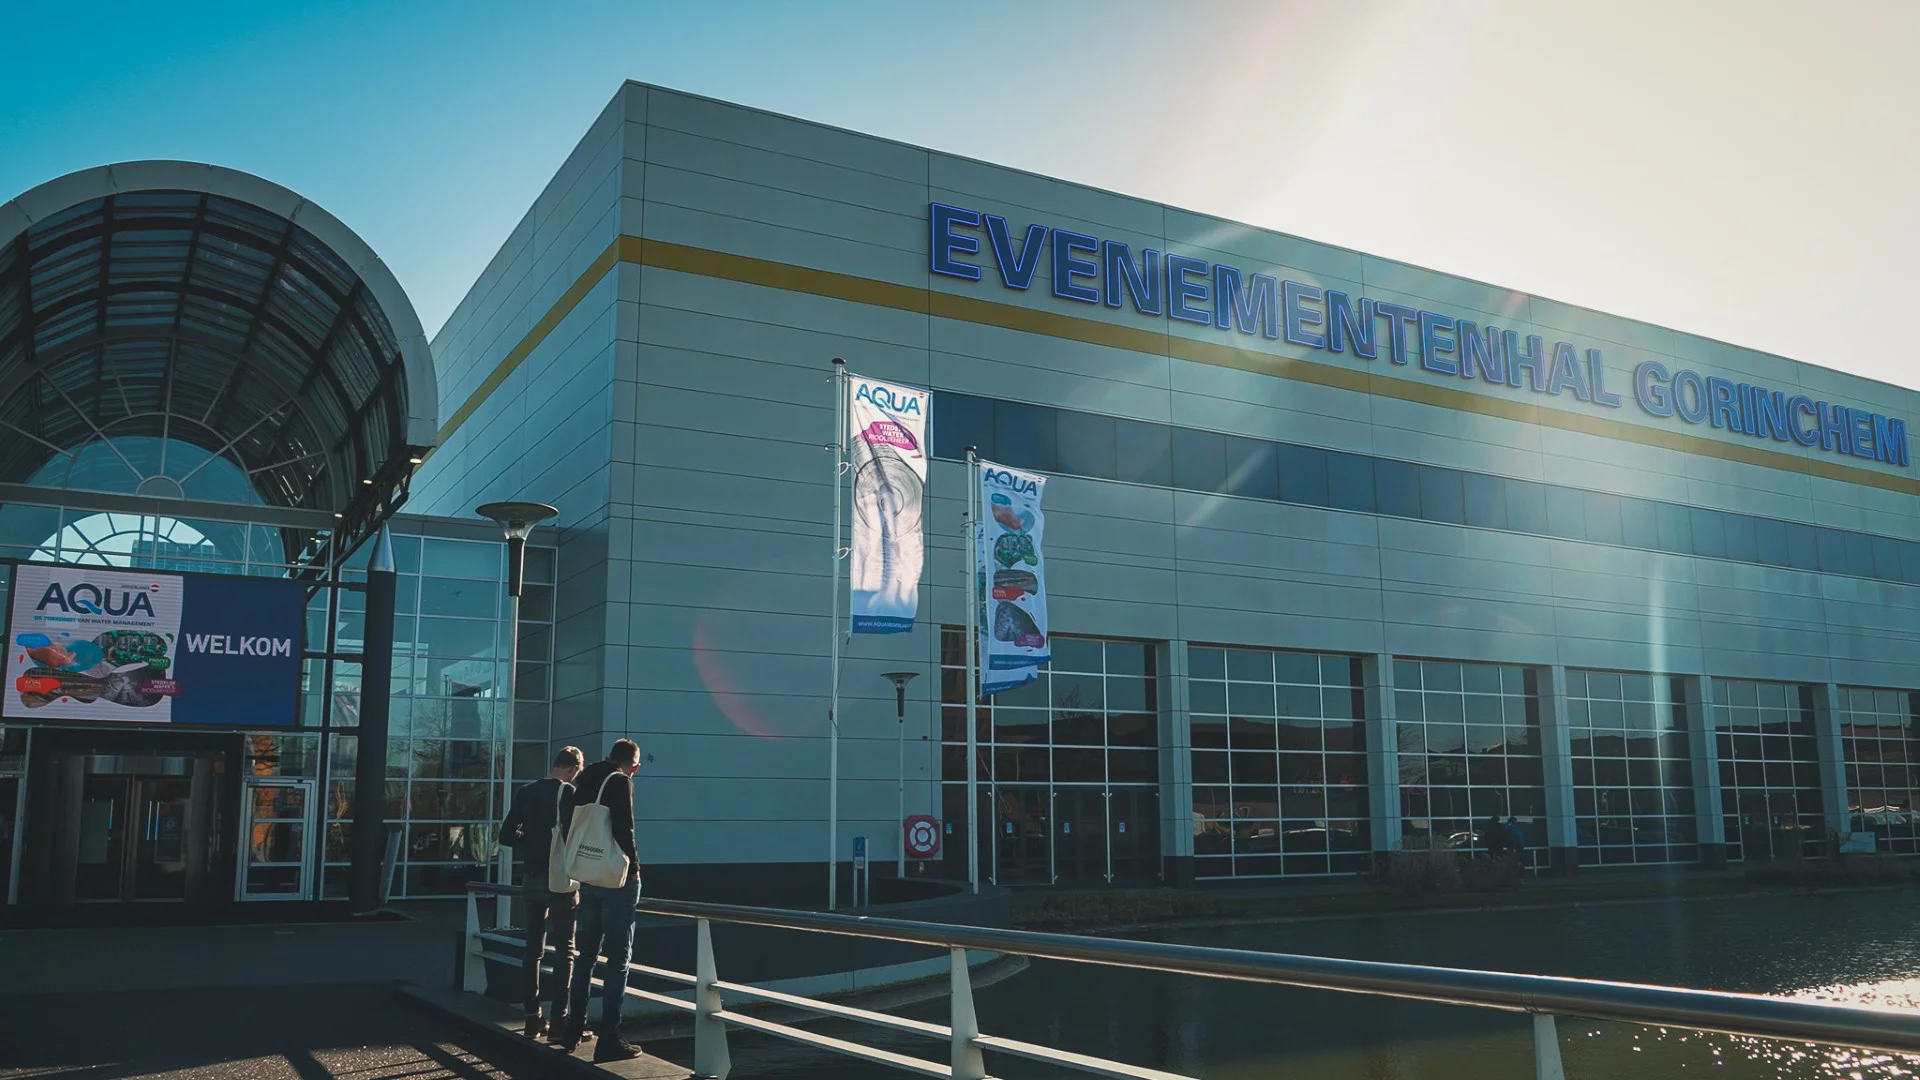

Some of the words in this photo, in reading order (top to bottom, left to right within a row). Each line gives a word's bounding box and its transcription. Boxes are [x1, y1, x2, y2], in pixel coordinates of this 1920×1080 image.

[928, 202, 1622, 408] EVENEMENTENHAL
[1633, 360, 1910, 467] GORINCHEM
[855, 383, 920, 415] AQUA
[984, 467, 1037, 496] AQUA
[36, 583, 155, 617] AQUA
[113, 619, 155, 627] MANAGEMENT
[186, 633, 291, 657] WELKOM
